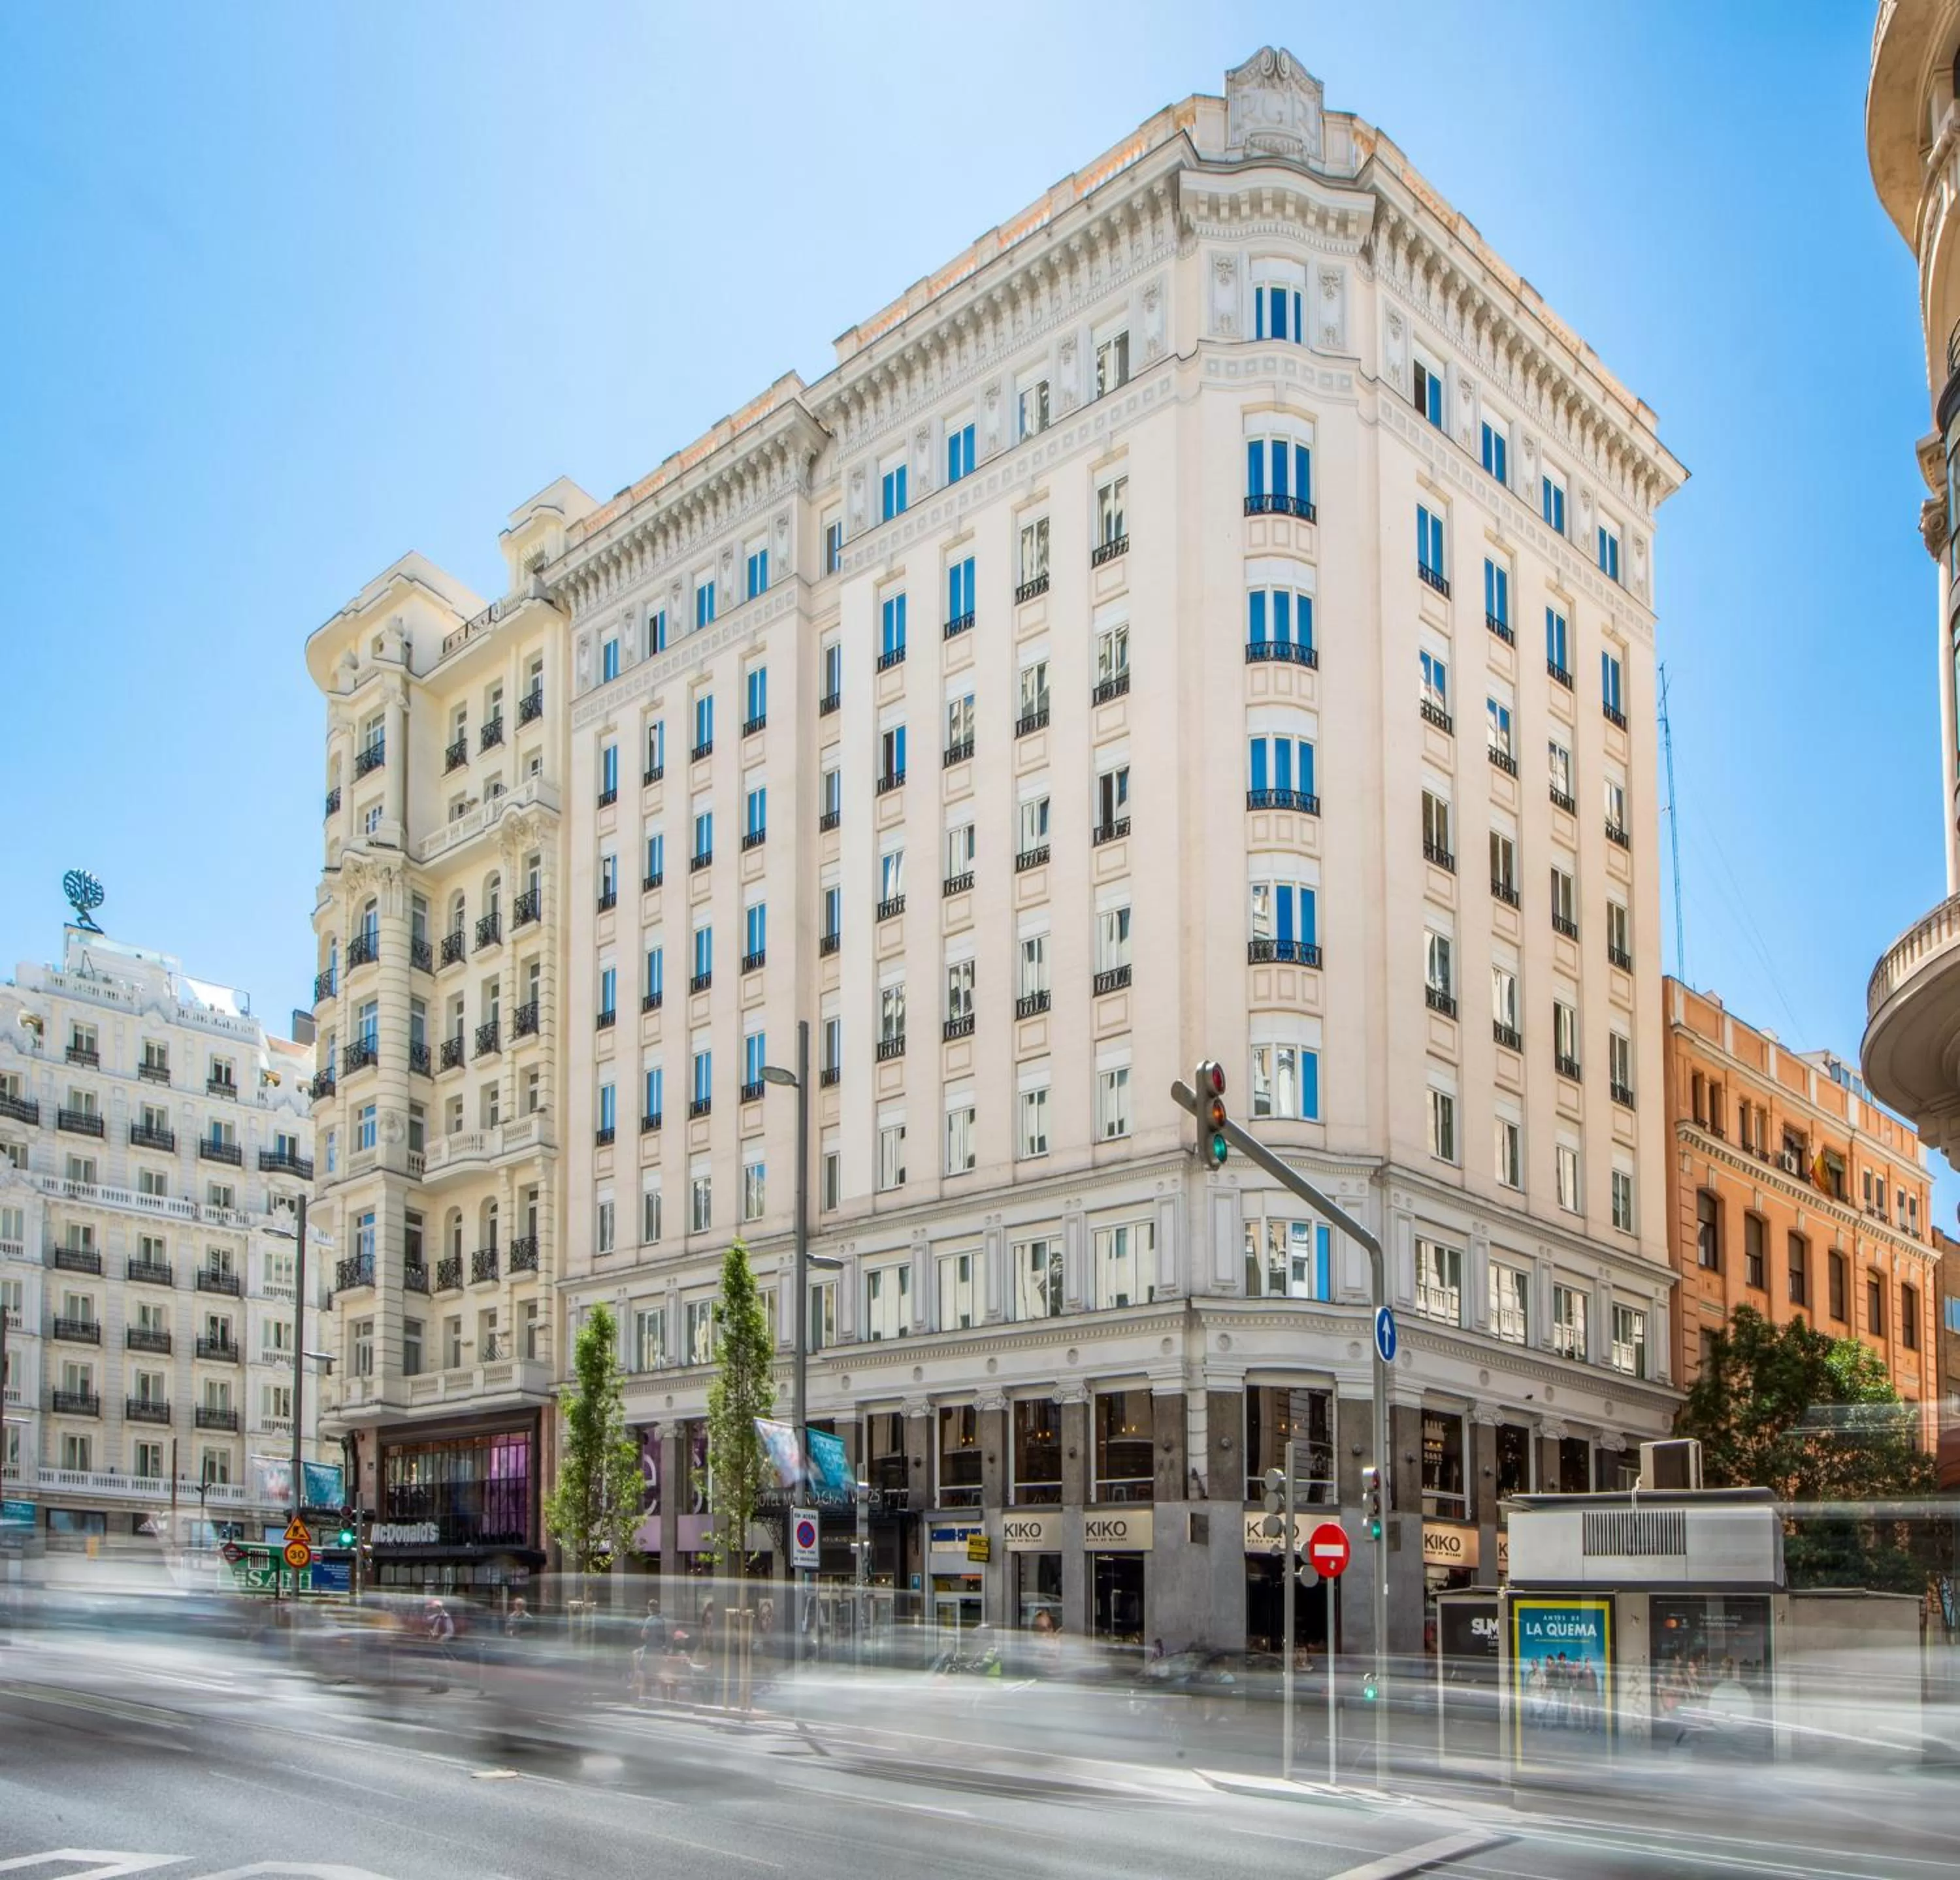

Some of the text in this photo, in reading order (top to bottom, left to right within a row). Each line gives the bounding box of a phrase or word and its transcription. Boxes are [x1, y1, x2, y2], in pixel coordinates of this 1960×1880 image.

[370, 1521, 440, 1542] McDonald's
[1004, 1523, 1041, 1538] KIKO
[1085, 1521, 1127, 1537] KIKO
[1247, 1521, 1299, 1538] KO
[1424, 1534, 1460, 1552] KIKO
[290, 1549, 305, 1559] 30
[1526, 1623, 1597, 1637] LA QUEMA
